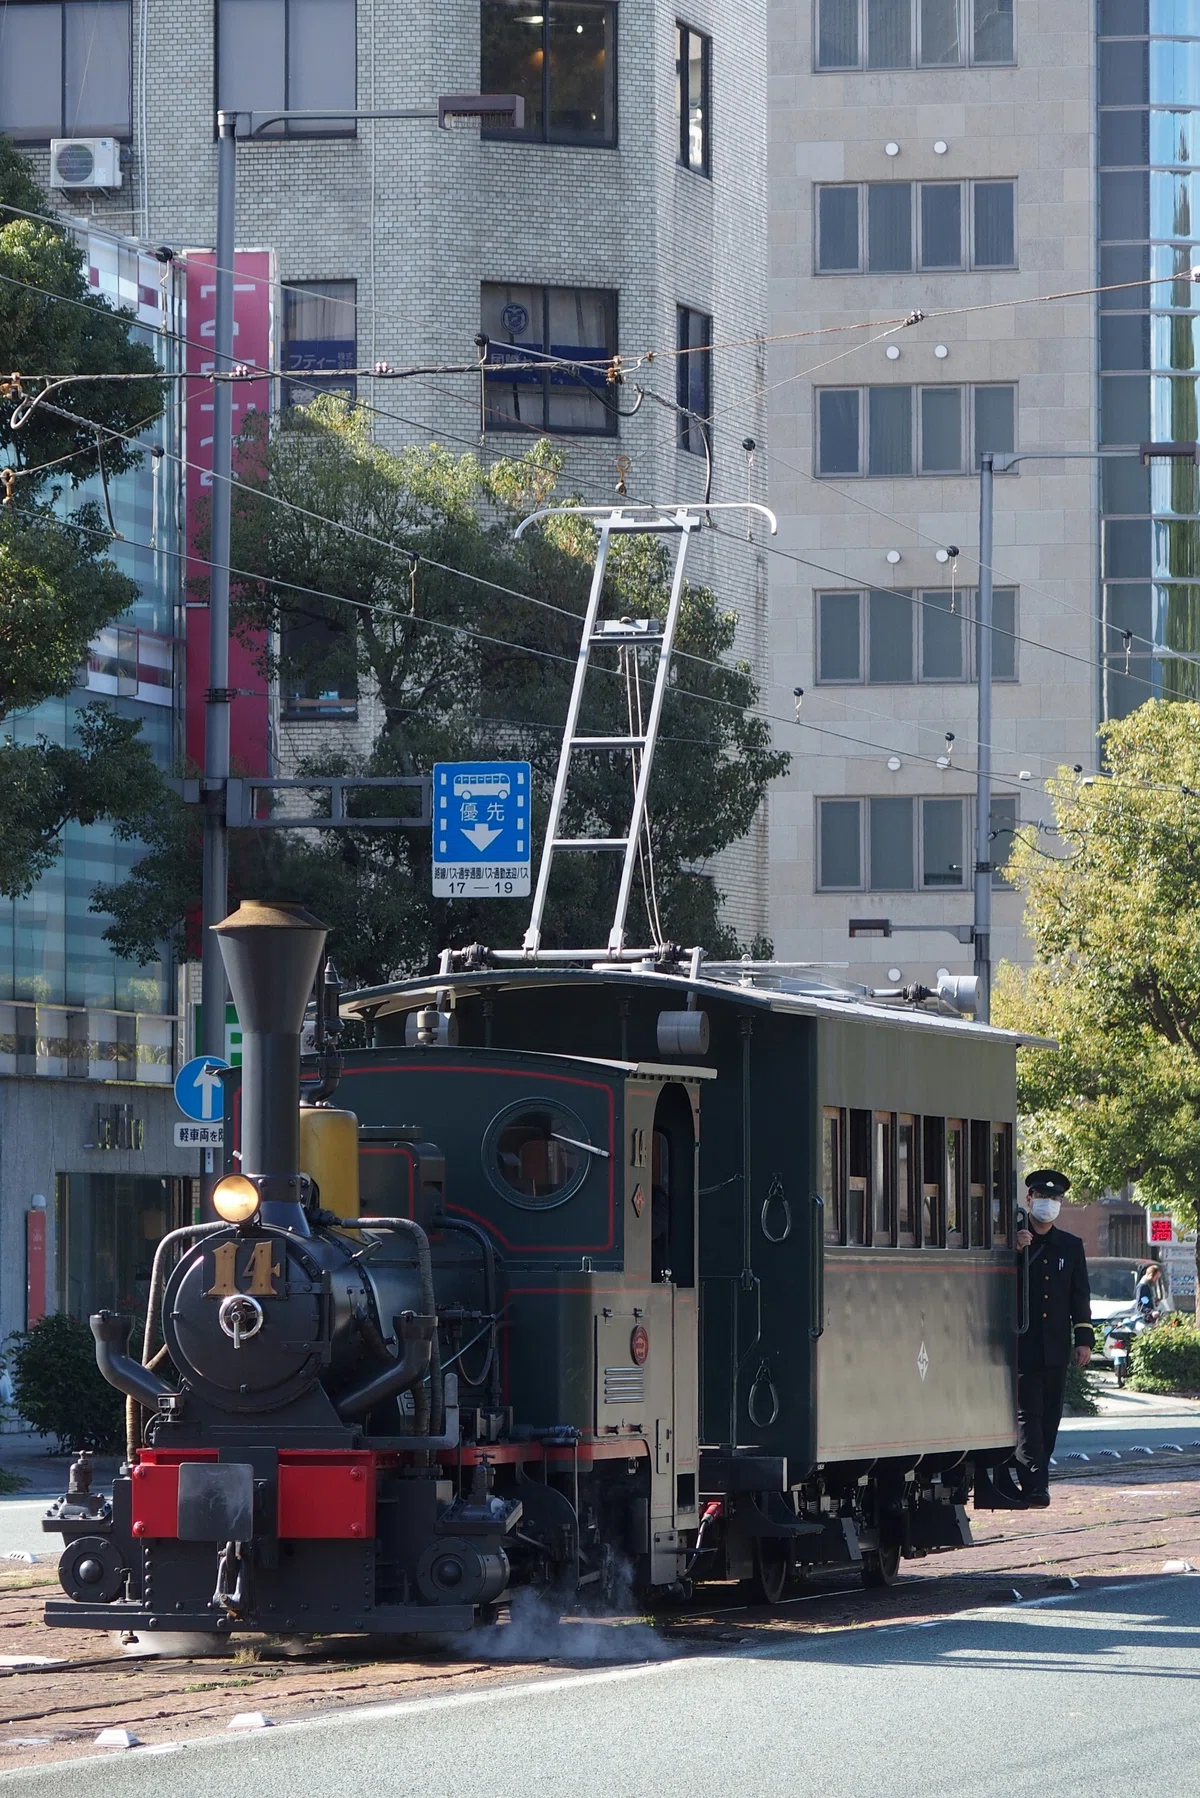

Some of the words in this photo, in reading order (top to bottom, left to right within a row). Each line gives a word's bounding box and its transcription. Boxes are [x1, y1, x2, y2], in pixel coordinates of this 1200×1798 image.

[448, 882, 466, 894] 17
[494, 881, 513, 894] 19
[633, 1127, 648, 1168] 14
[207, 1241, 281, 1295] 14
